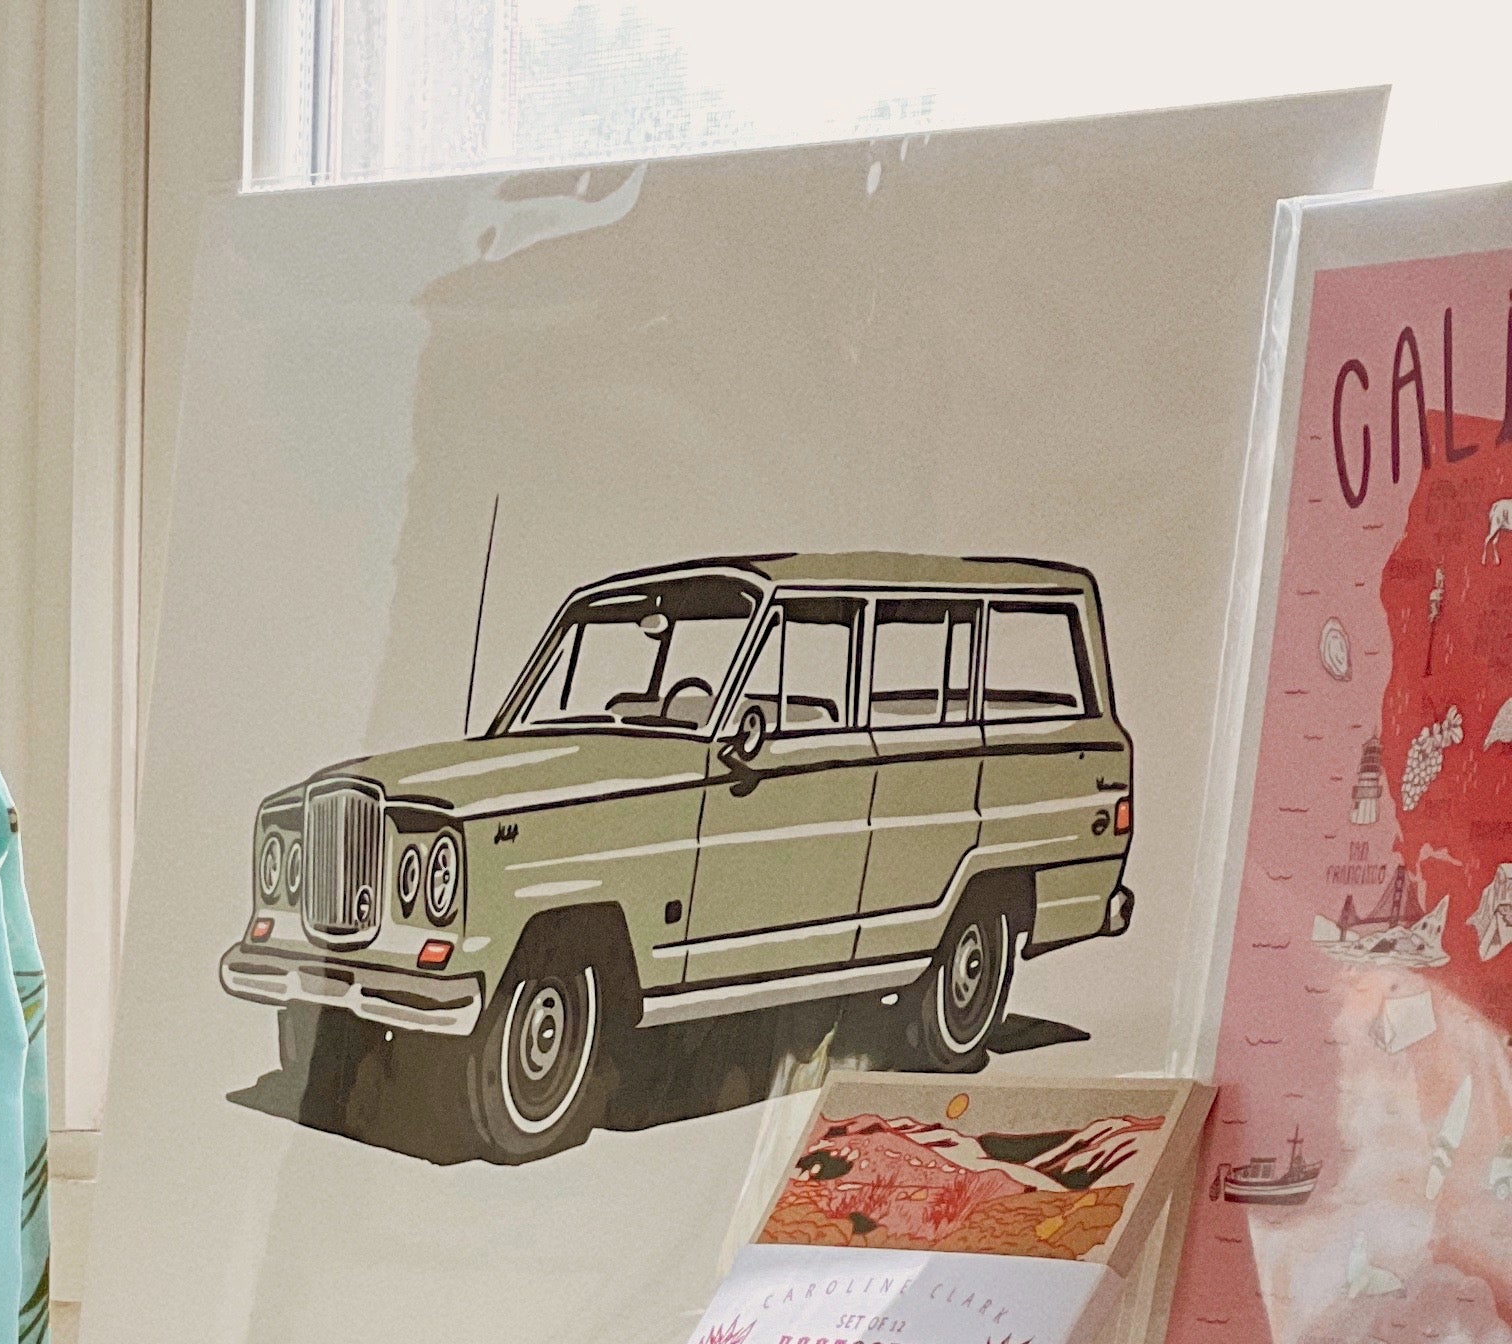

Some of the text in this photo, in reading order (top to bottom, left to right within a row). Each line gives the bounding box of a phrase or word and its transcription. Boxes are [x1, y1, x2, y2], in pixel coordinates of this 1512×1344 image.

[762, 1276, 1009, 1325] CAROLINE CLARK
[835, 1313, 862, 1330] SET
[866, 1315, 887, 1331] OF
